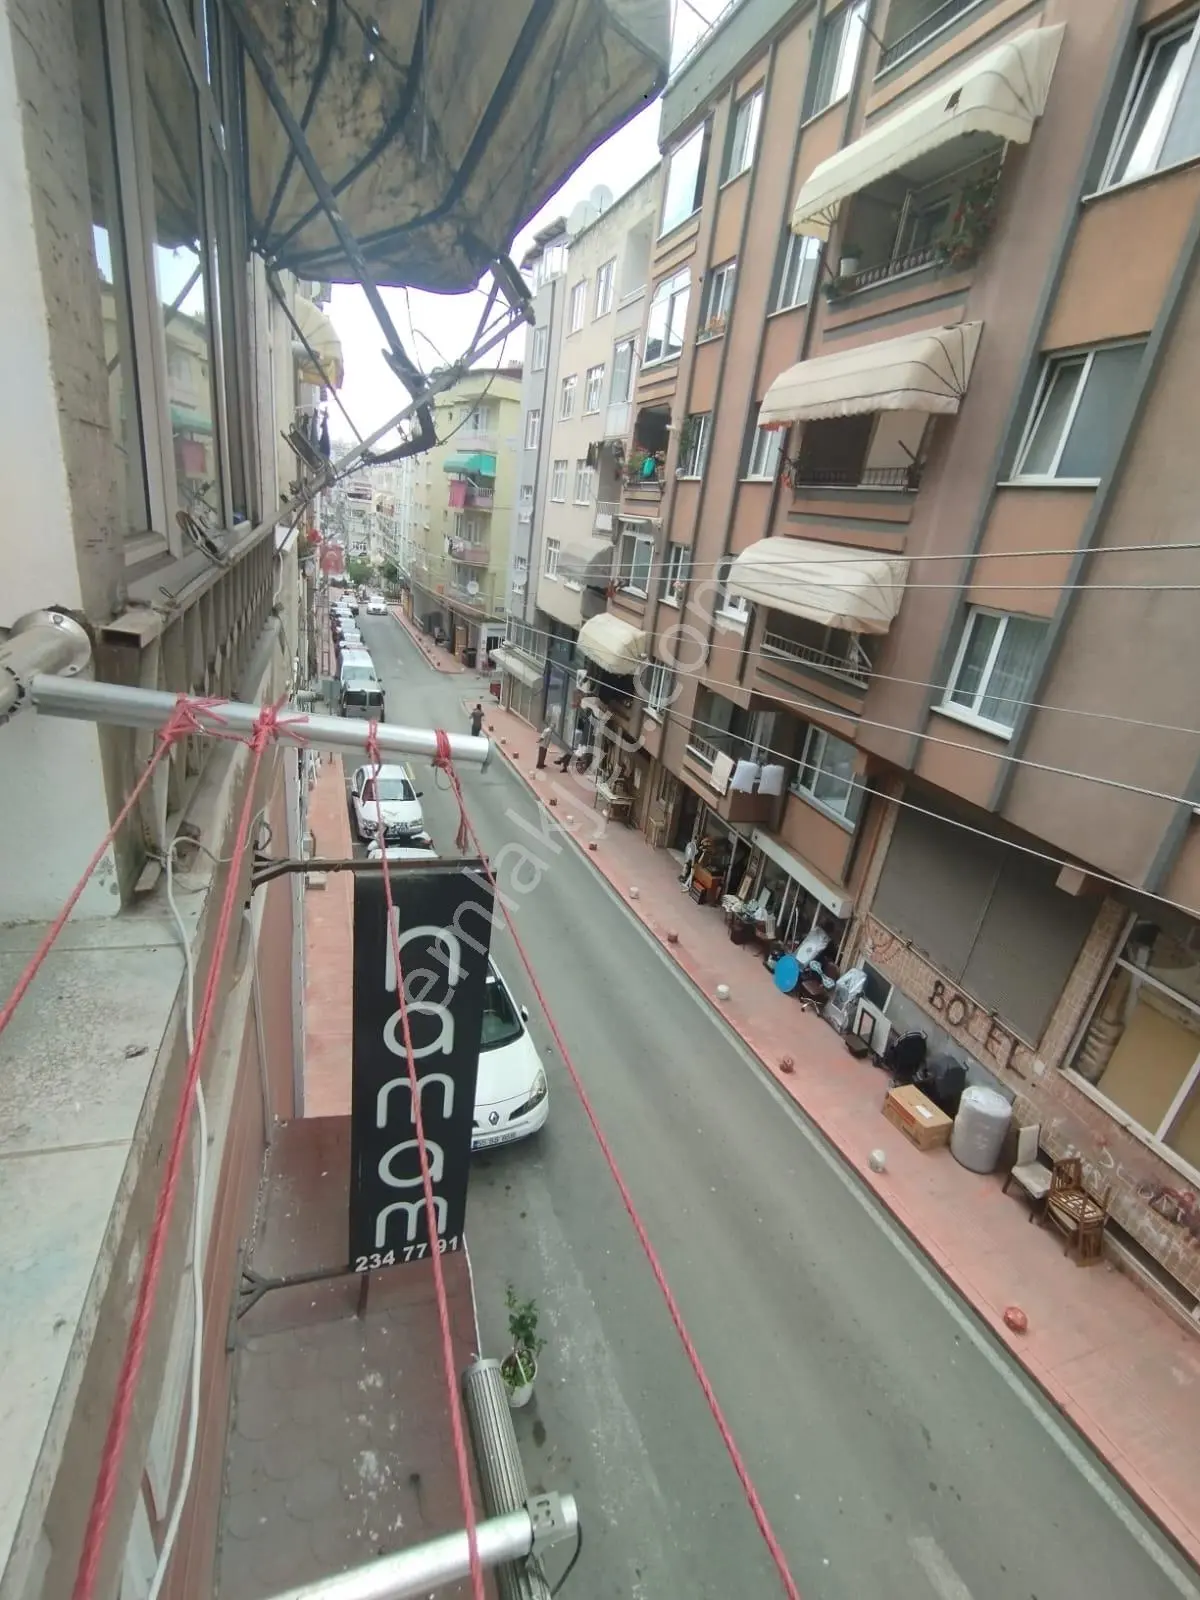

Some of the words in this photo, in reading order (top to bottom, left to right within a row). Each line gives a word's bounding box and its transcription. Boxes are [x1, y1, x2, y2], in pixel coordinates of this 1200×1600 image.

[375, 905, 461, 1248] hamam
[355, 1249, 396, 1273] 234
[403, 1242, 428, 1262] 77
[436, 1235, 458, 1255] 91
